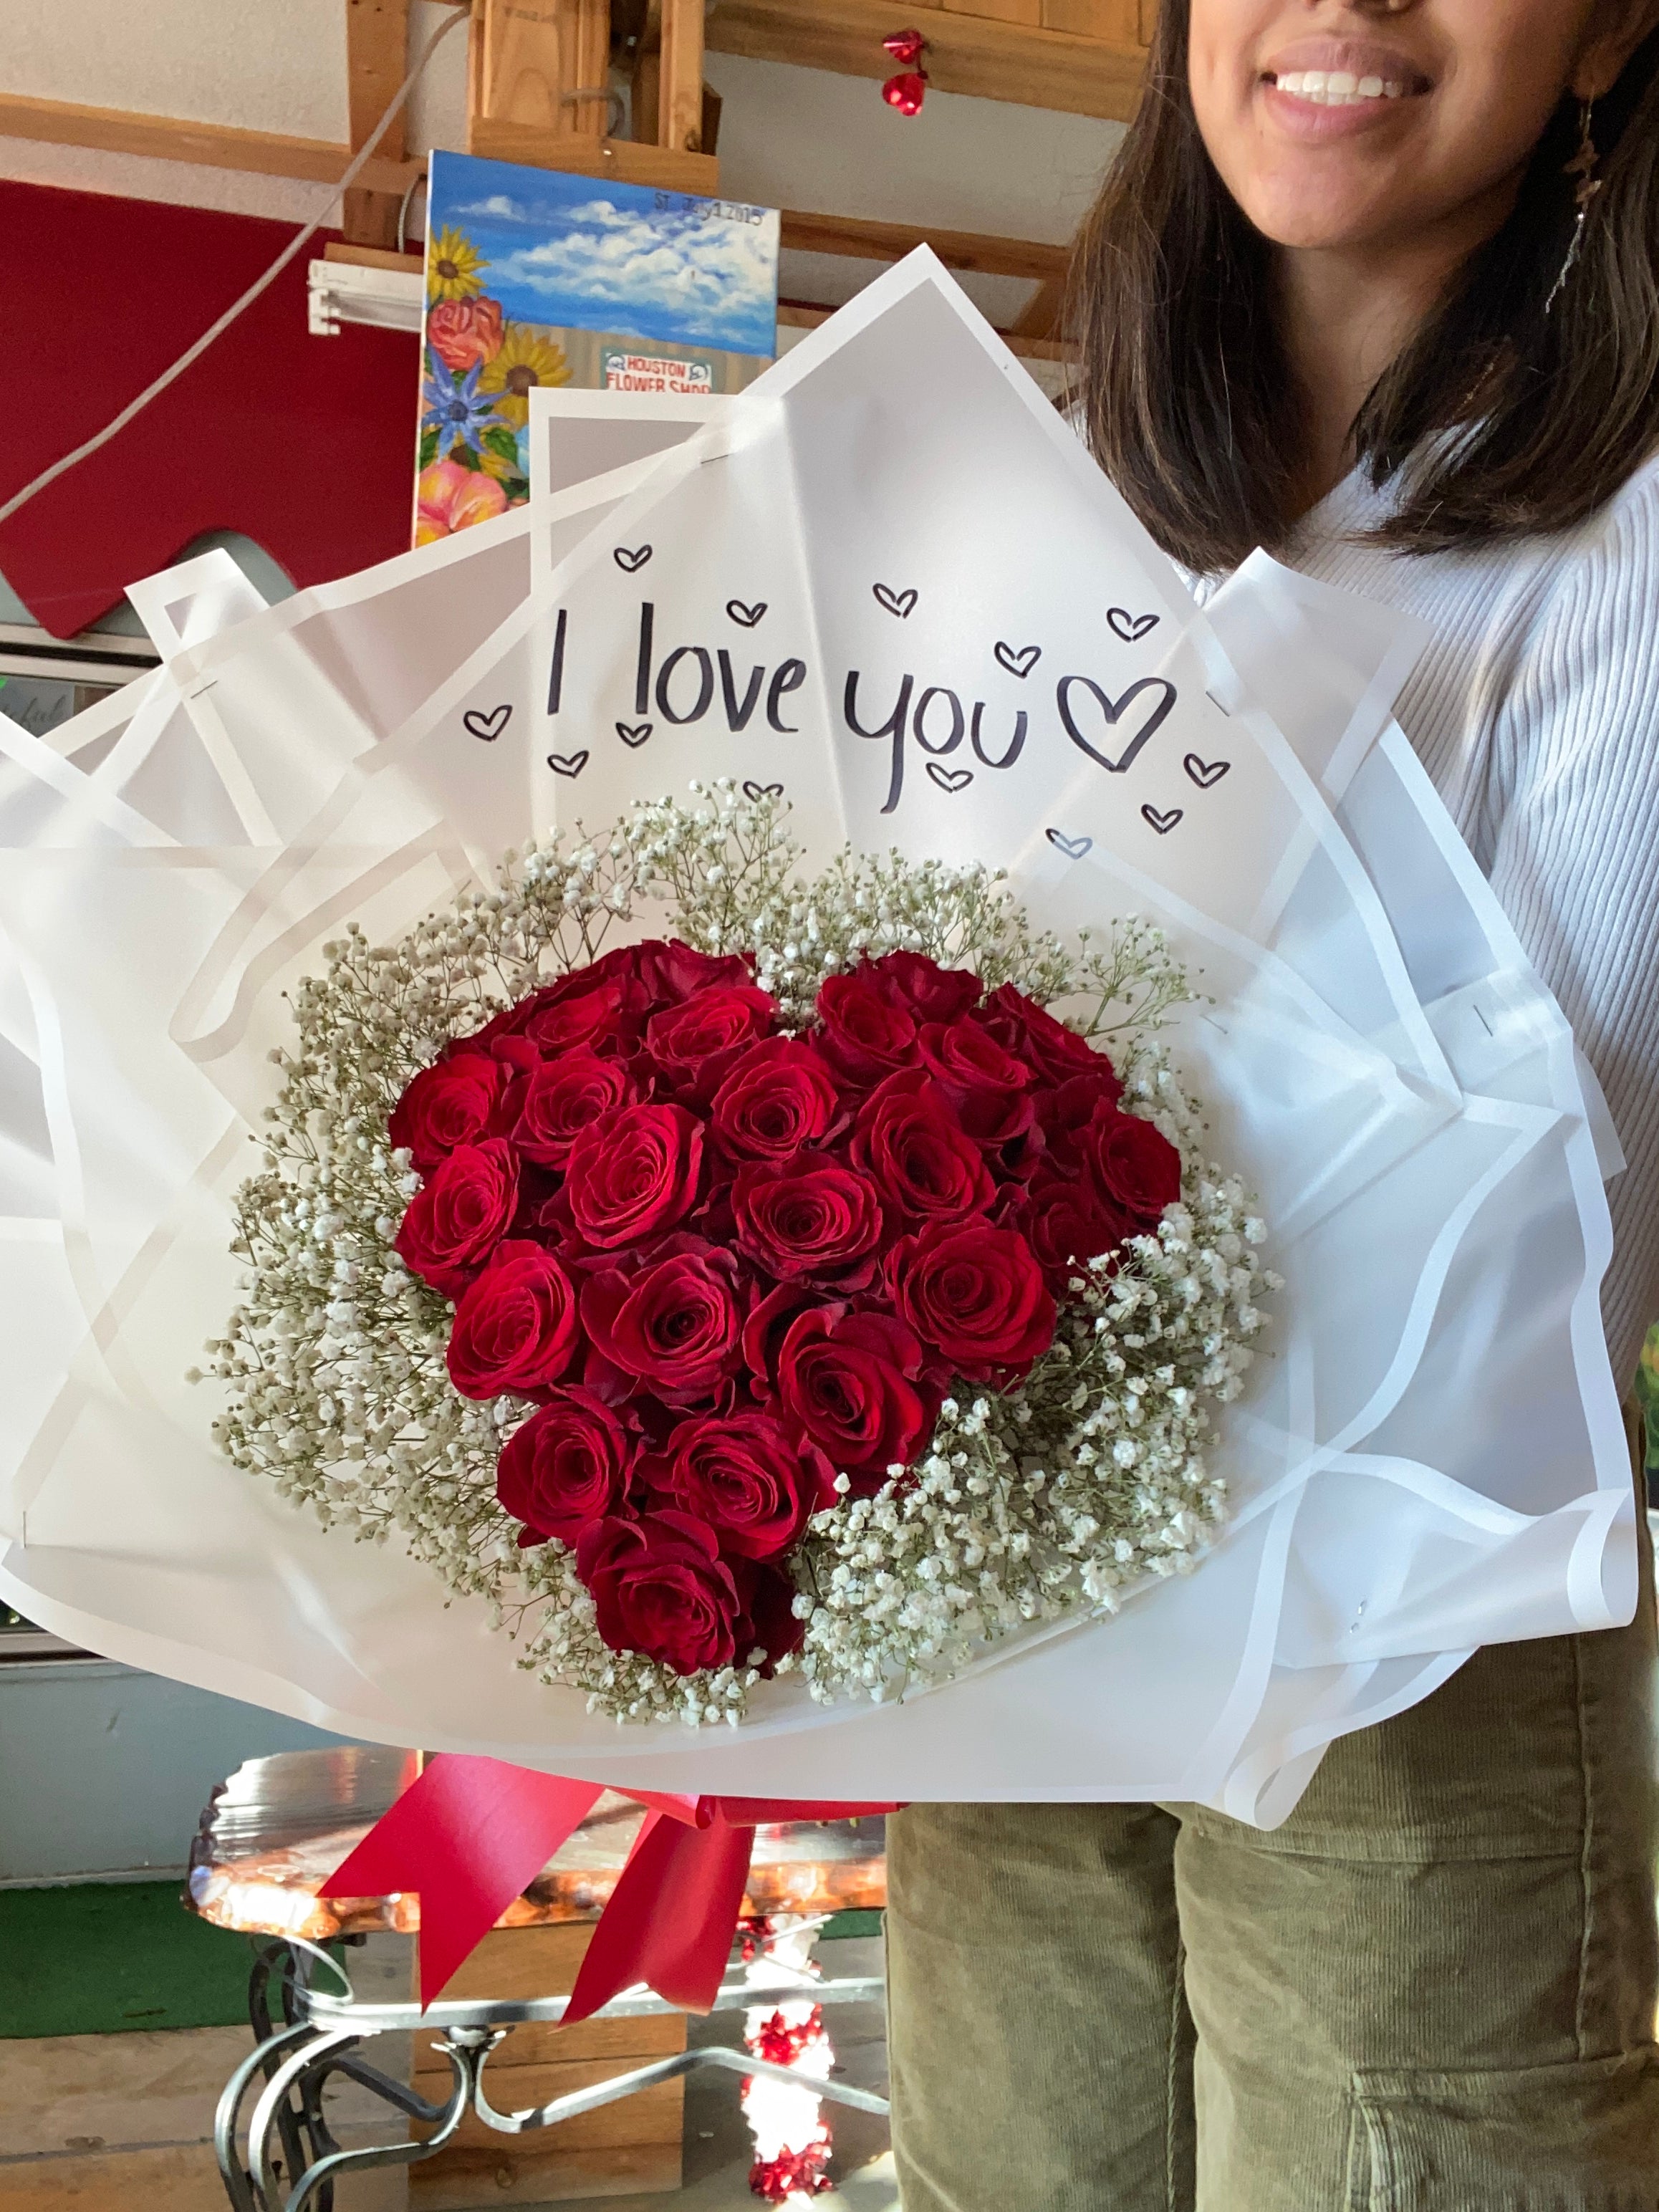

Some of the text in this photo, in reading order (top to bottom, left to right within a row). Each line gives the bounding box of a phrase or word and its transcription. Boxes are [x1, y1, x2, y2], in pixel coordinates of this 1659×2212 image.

[627, 355, 686, 378] HOUSTON
[606, 372, 665, 393] FLOWER
[547, 602, 1028, 815] I love you
